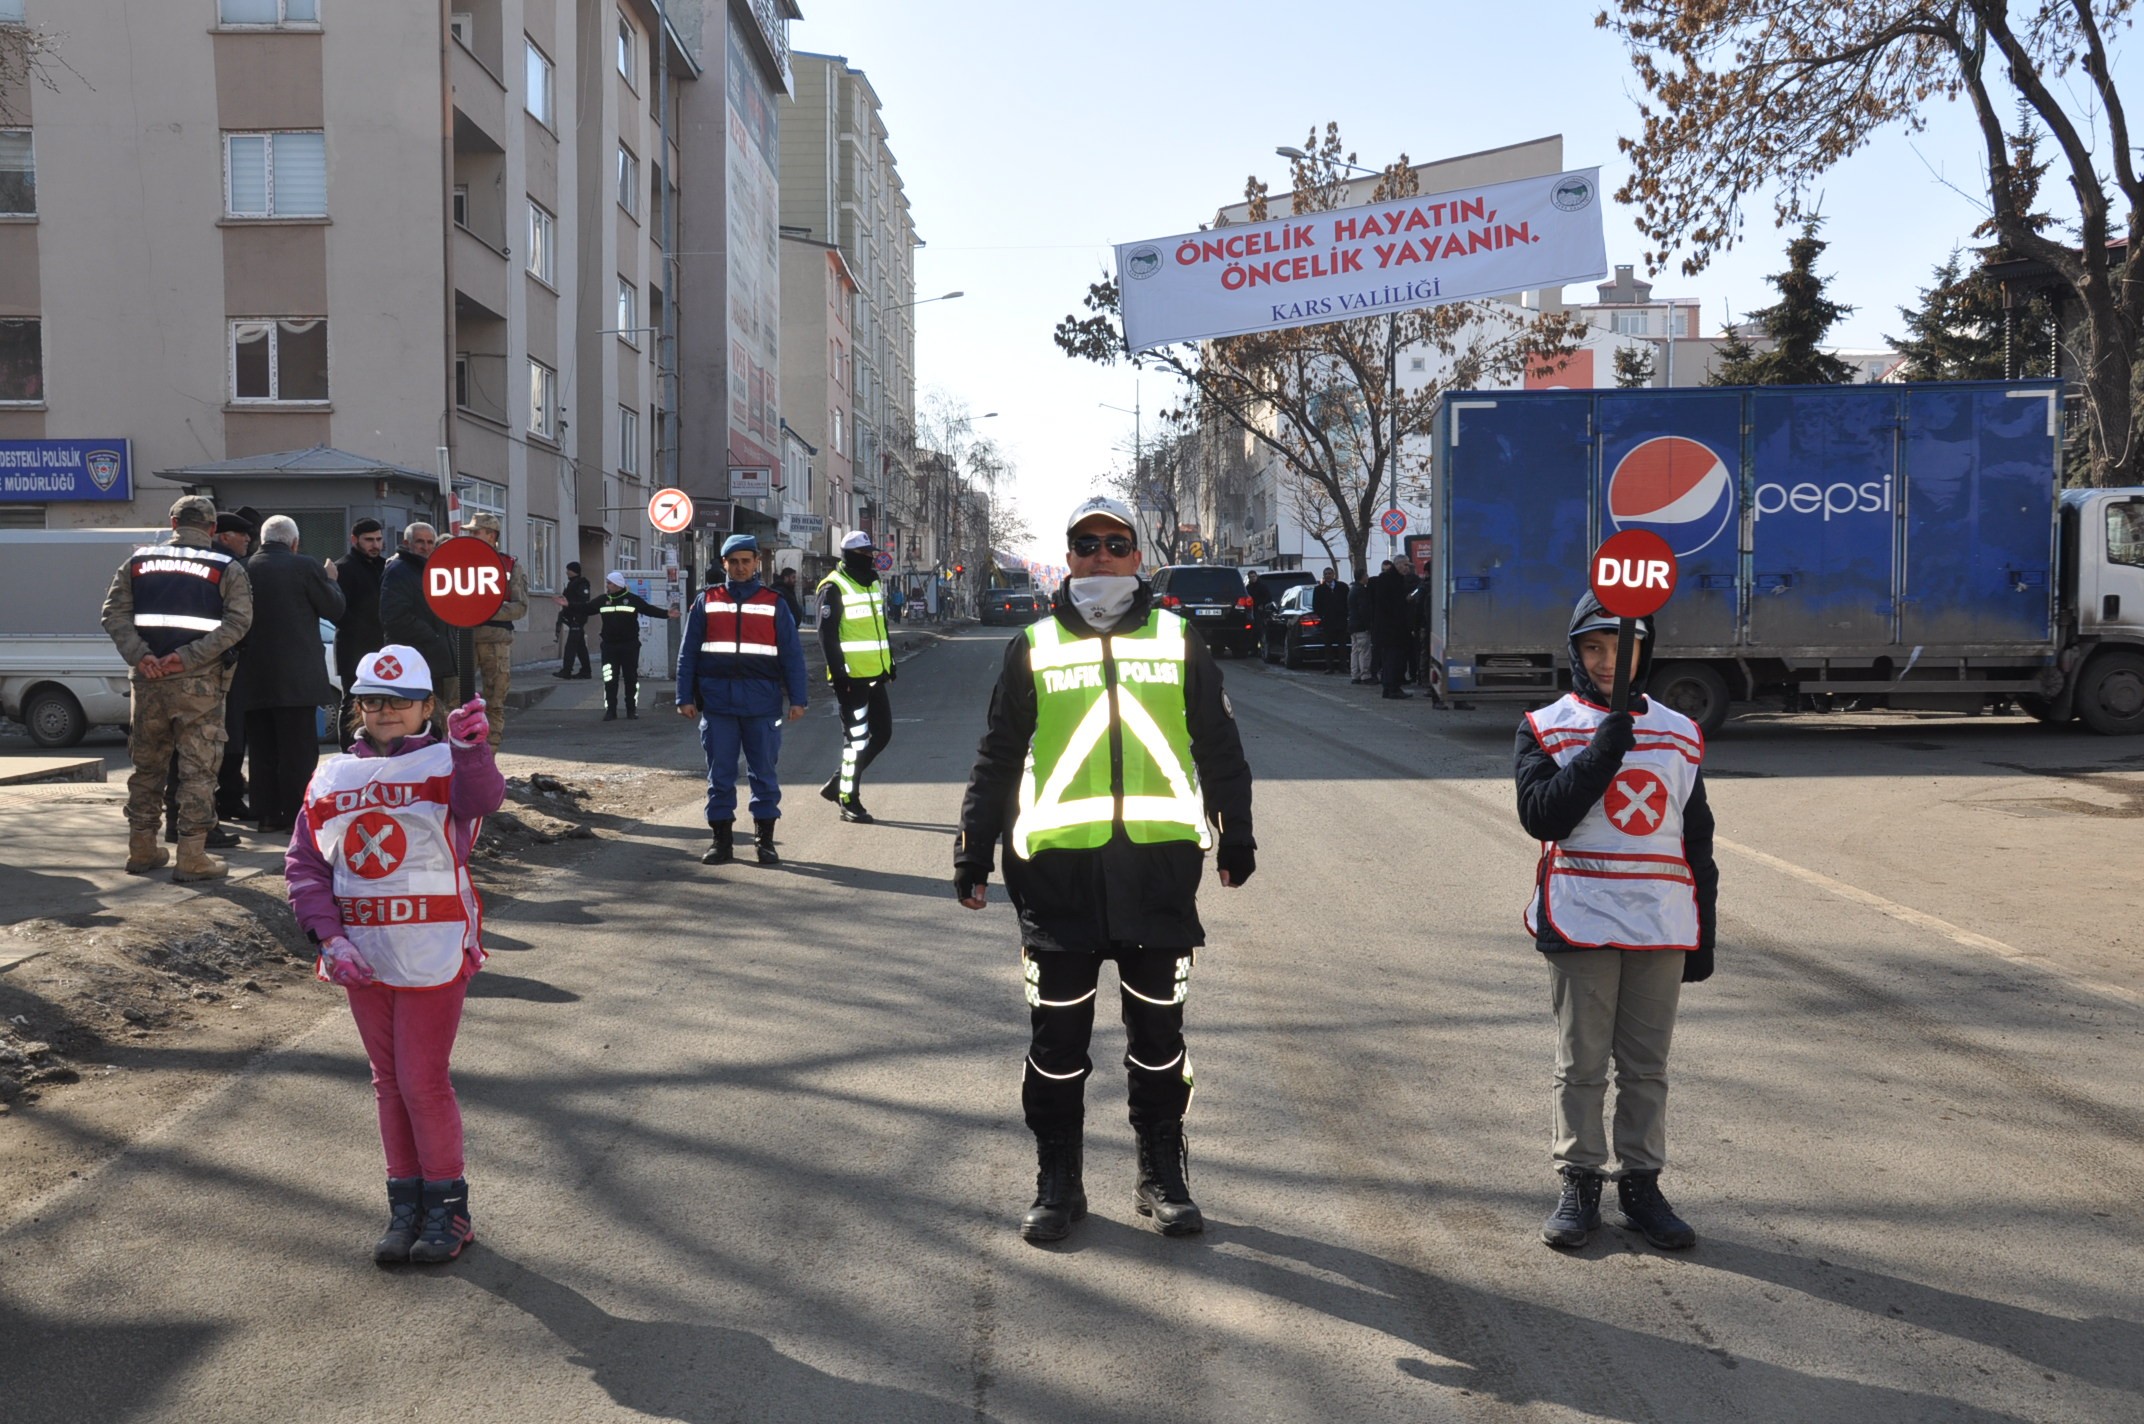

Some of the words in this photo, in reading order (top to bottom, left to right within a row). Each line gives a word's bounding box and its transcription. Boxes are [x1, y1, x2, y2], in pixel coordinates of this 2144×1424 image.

[1175, 223, 1315, 266] ÖNCELİK
[1334, 196, 1498, 243] HAYATIN,
[1221, 246, 1363, 291] ÖNCELİK
[1373, 221, 1541, 269] YAYANIN.
[1271, 297, 1332, 322] KARS
[1338, 277, 1442, 310] VALİLİĞİ
[0, 447, 40, 468] DESTEKLİ
[43, 447, 81, 468] POLİSLİK
[5, 473, 75, 491] MÜDÜRLÜĞÜ
[1754, 474, 1892, 522] pepsi
[139, 559, 210, 579] JANDARMA
[430, 566, 501, 596] DUR
[1597, 558, 1670, 589] DUR
[335, 783, 421, 812] OKUL
